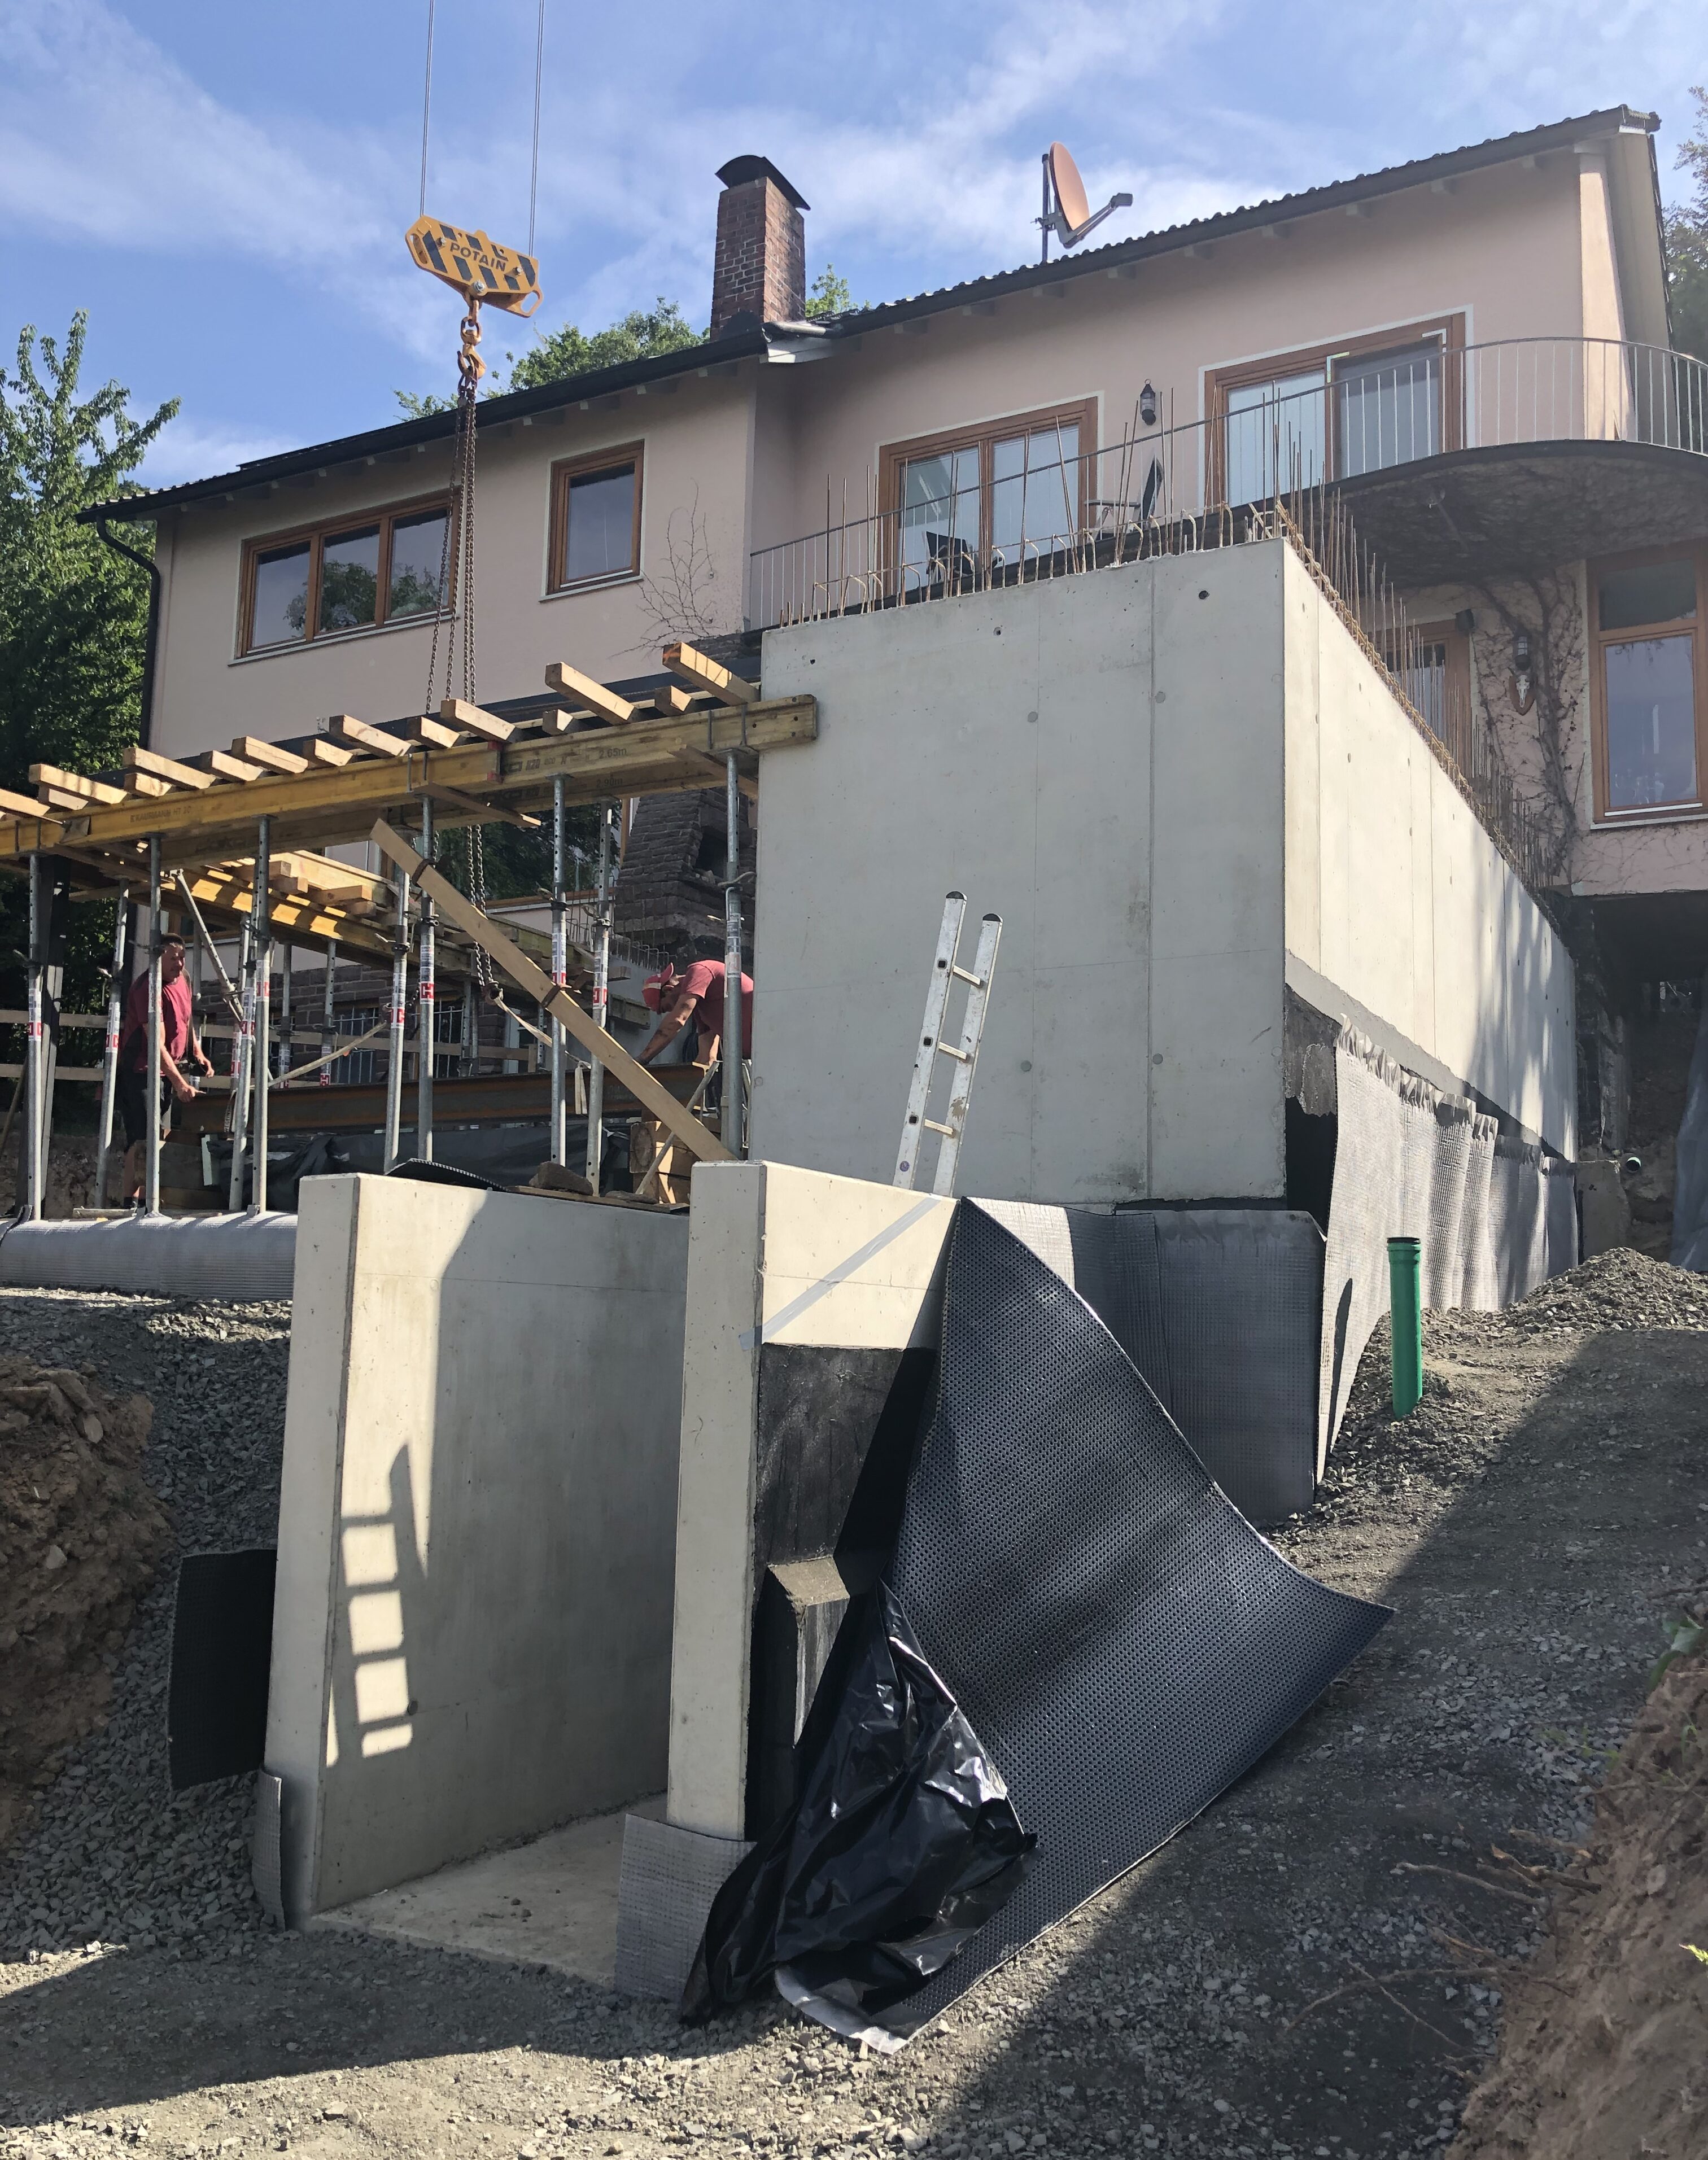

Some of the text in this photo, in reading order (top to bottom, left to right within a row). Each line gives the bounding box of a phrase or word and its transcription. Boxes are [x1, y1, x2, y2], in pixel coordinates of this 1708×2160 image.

[450, 243, 506, 272] POTAIN
[599, 747, 627, 759] 2.65m
[596, 776, 623, 788] 2.90m
